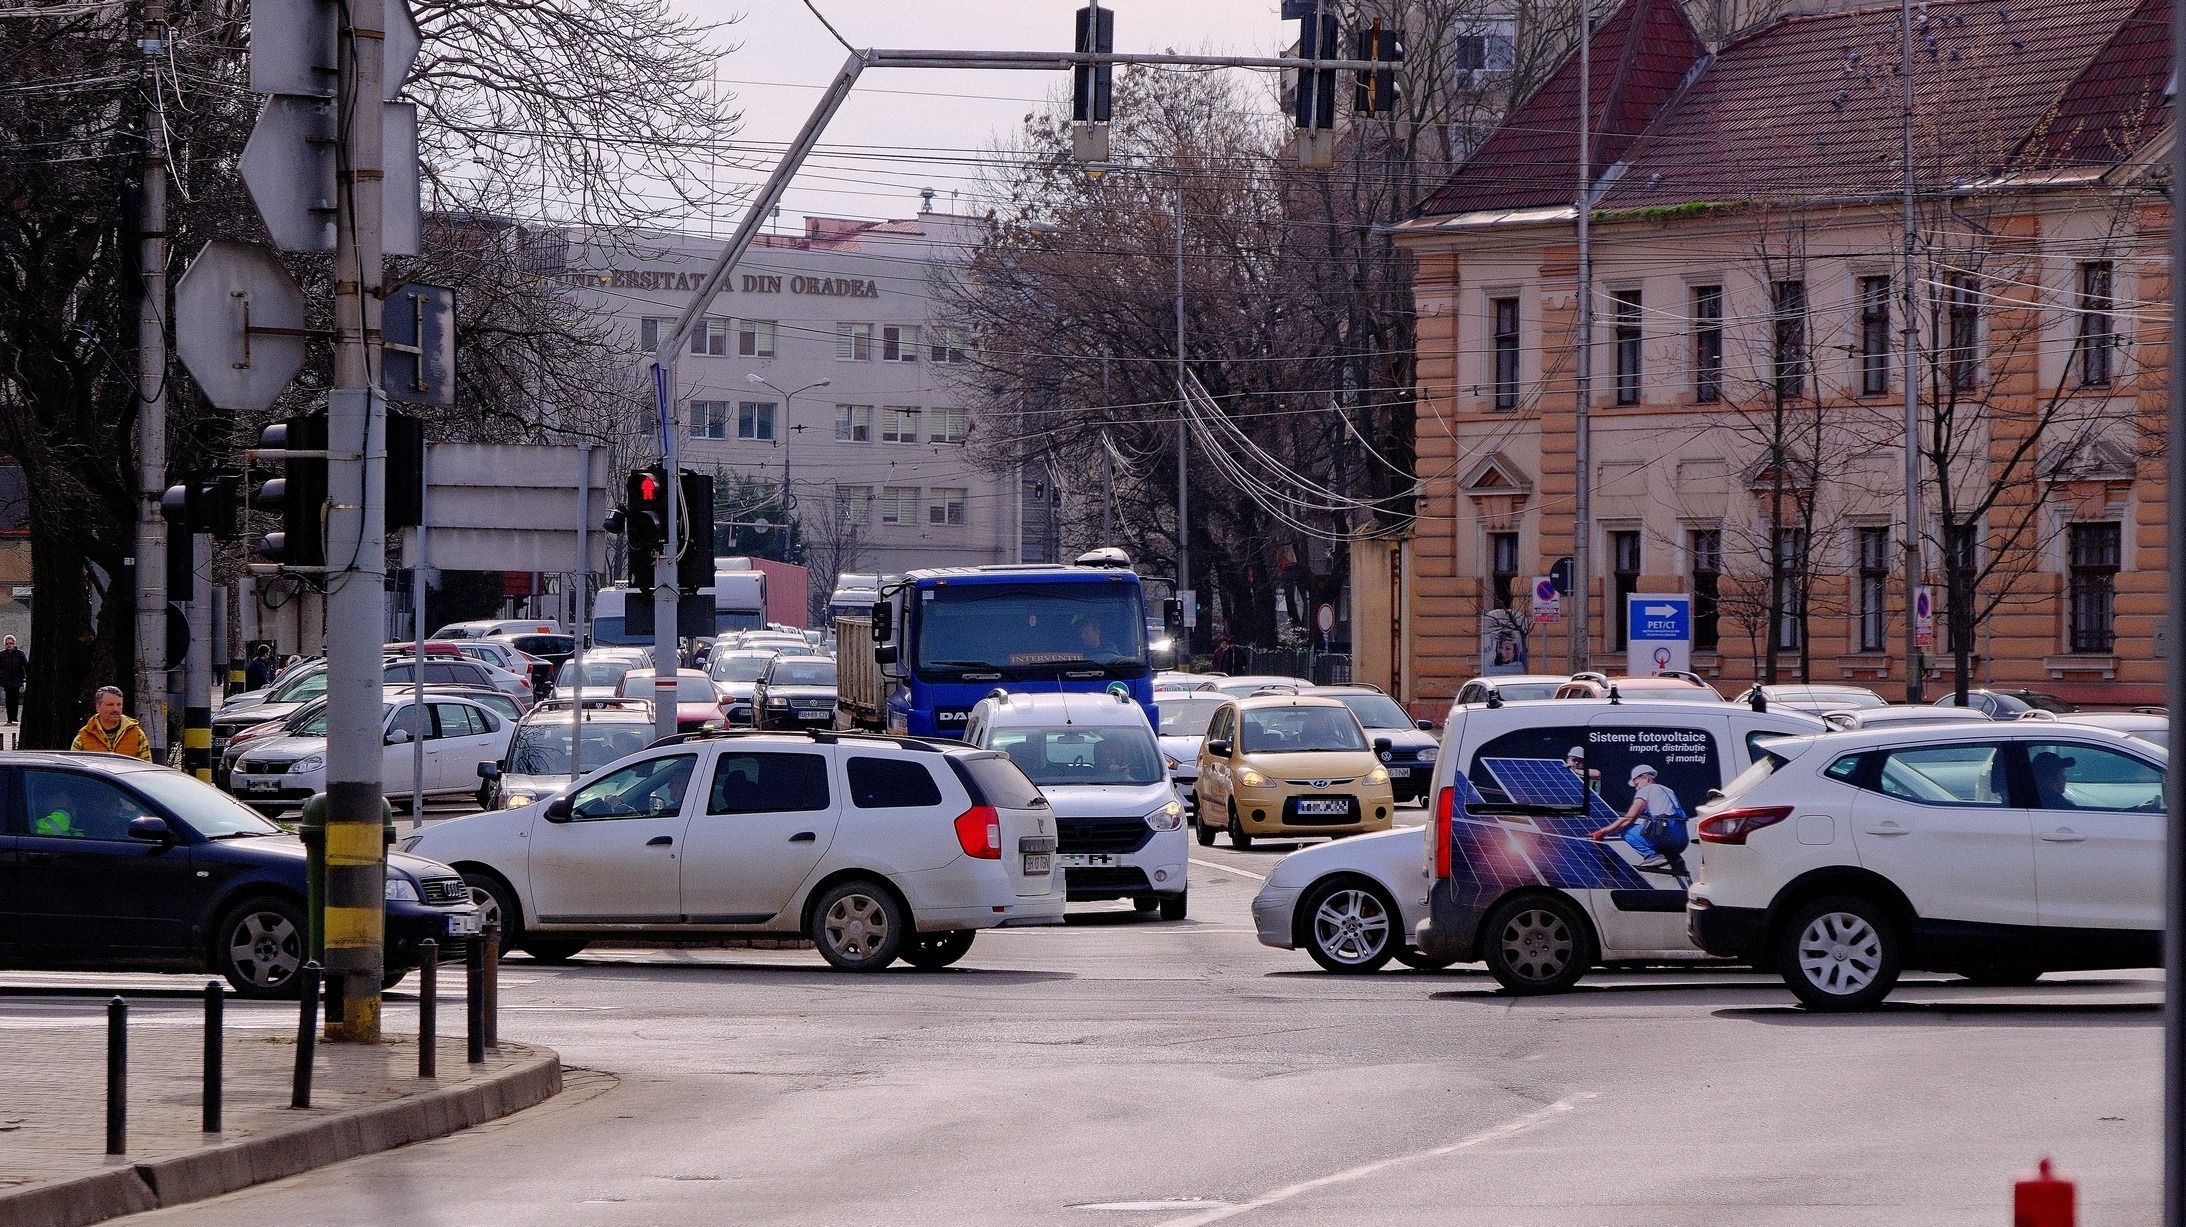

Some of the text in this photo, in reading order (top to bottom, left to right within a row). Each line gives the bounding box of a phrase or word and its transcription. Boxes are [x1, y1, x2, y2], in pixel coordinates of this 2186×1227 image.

[742, 275, 782, 293] DIN
[791, 276, 879, 297] ORADEA
[1648, 621, 1676, 629] PET/CT
[1589, 732, 1706, 742] Sisteme fotovoltaice
[1629, 744, 1660, 753] import,
[1676, 754, 1706, 763] montaj
